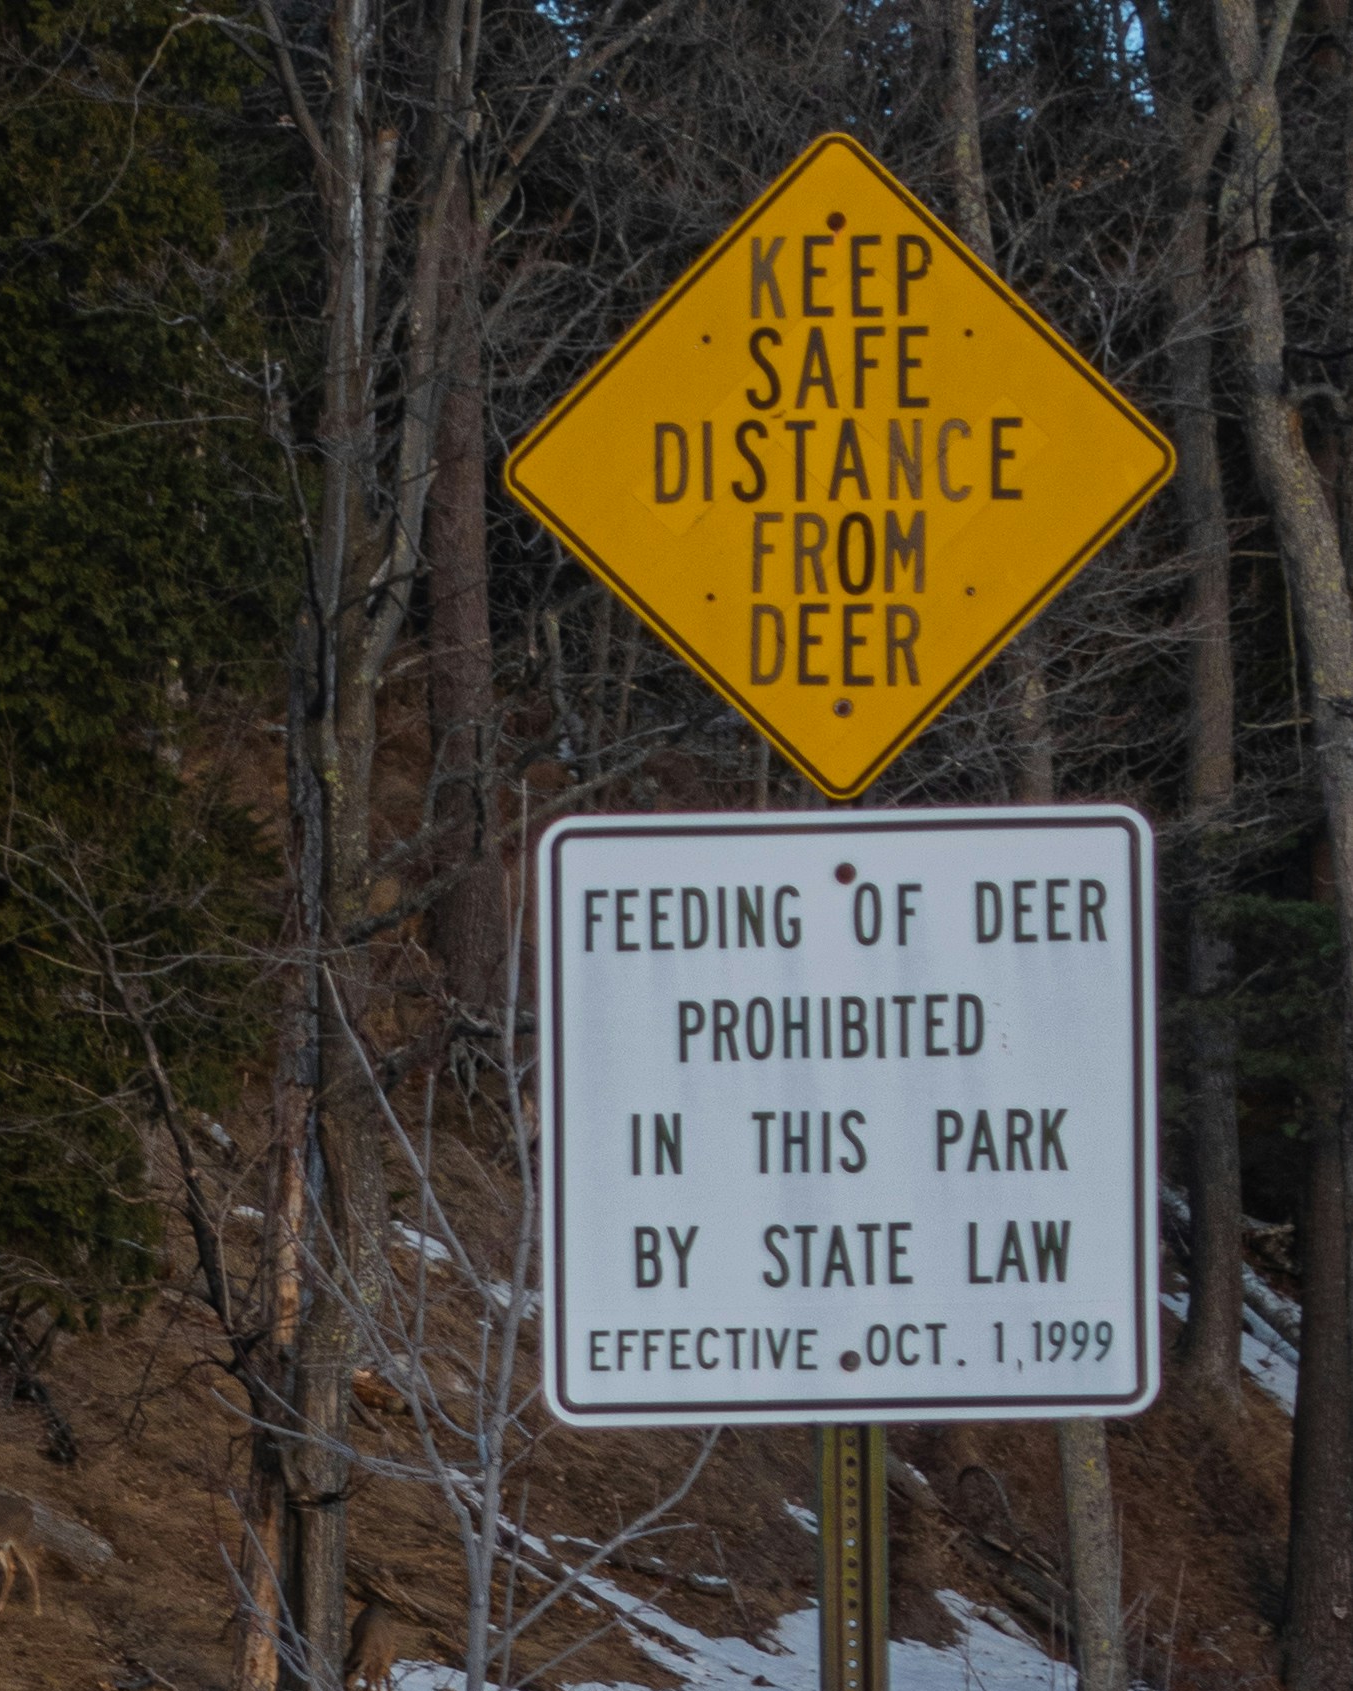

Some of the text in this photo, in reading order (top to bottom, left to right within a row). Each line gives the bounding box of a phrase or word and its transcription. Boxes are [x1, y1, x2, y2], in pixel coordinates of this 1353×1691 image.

[750, 235, 933, 318] KEEP
[746, 326, 929, 410] SAFE
[654, 417, 1023, 504] DISTANCE
[752, 510, 926, 595] FROM
[750, 603, 921, 686] DEER
[584, 878, 1108, 952] FEEDING OF DEER
[678, 993, 985, 1063] PROHIBITED
[631, 1108, 1069, 1176] IN THIS PARK
[635, 1220, 1071, 1289] BY STATE LAW
[589, 1328, 818, 1372] EFFECTIVE
